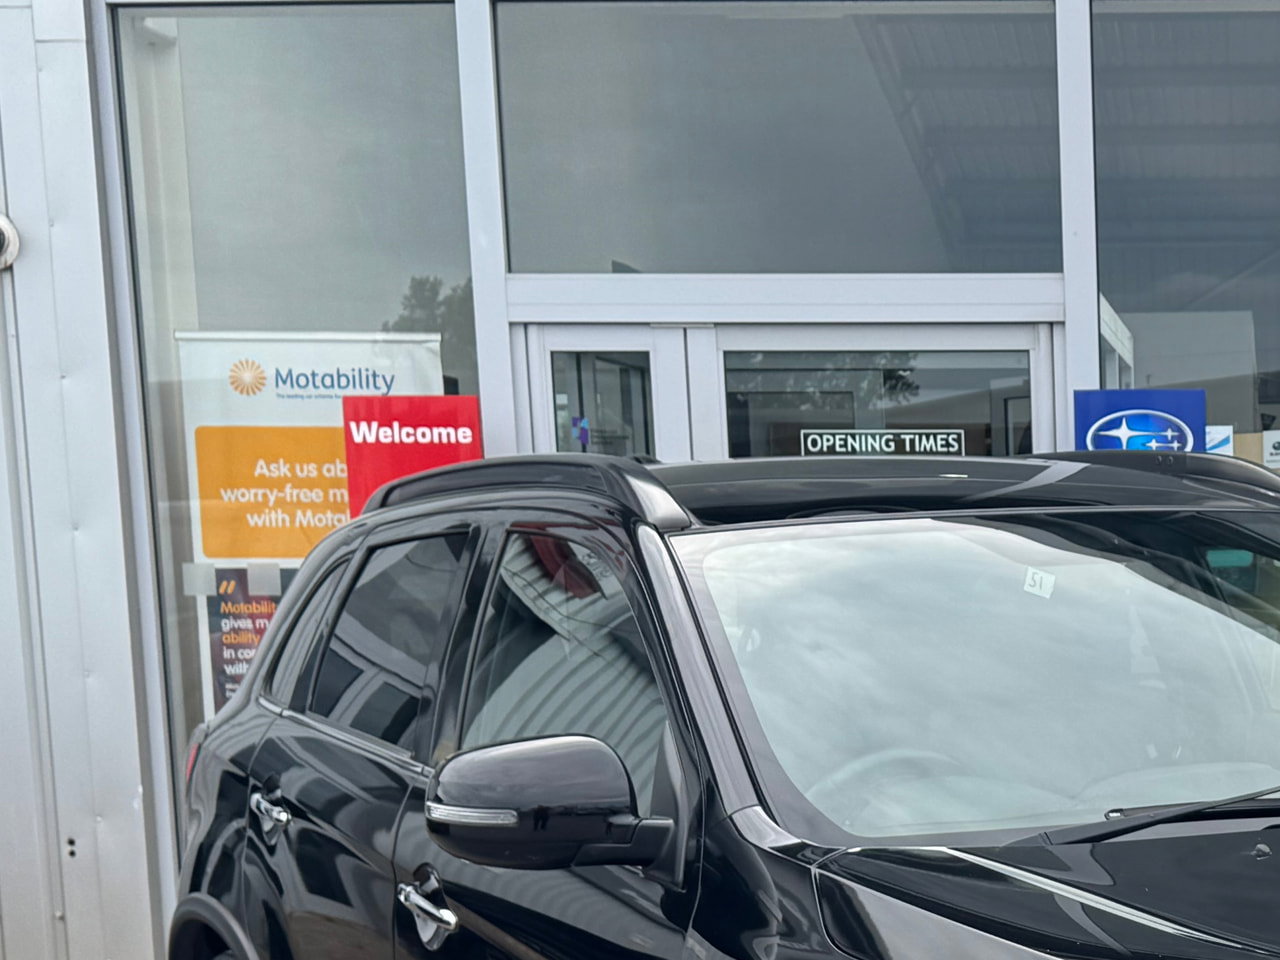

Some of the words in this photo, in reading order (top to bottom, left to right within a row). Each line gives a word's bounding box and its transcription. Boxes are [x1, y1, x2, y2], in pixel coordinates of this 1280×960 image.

[274, 367, 395, 396] Motability
[349, 420, 473, 444] Welcome
[806, 434, 896, 452] OPENING
[900, 434, 959, 452] TIMES
[254, 458, 292, 477] Ask
[295, 462, 318, 478] us
[220, 483, 324, 508] worry-free
[246, 508, 290, 527] with
[295, 508, 350, 528] Mota
